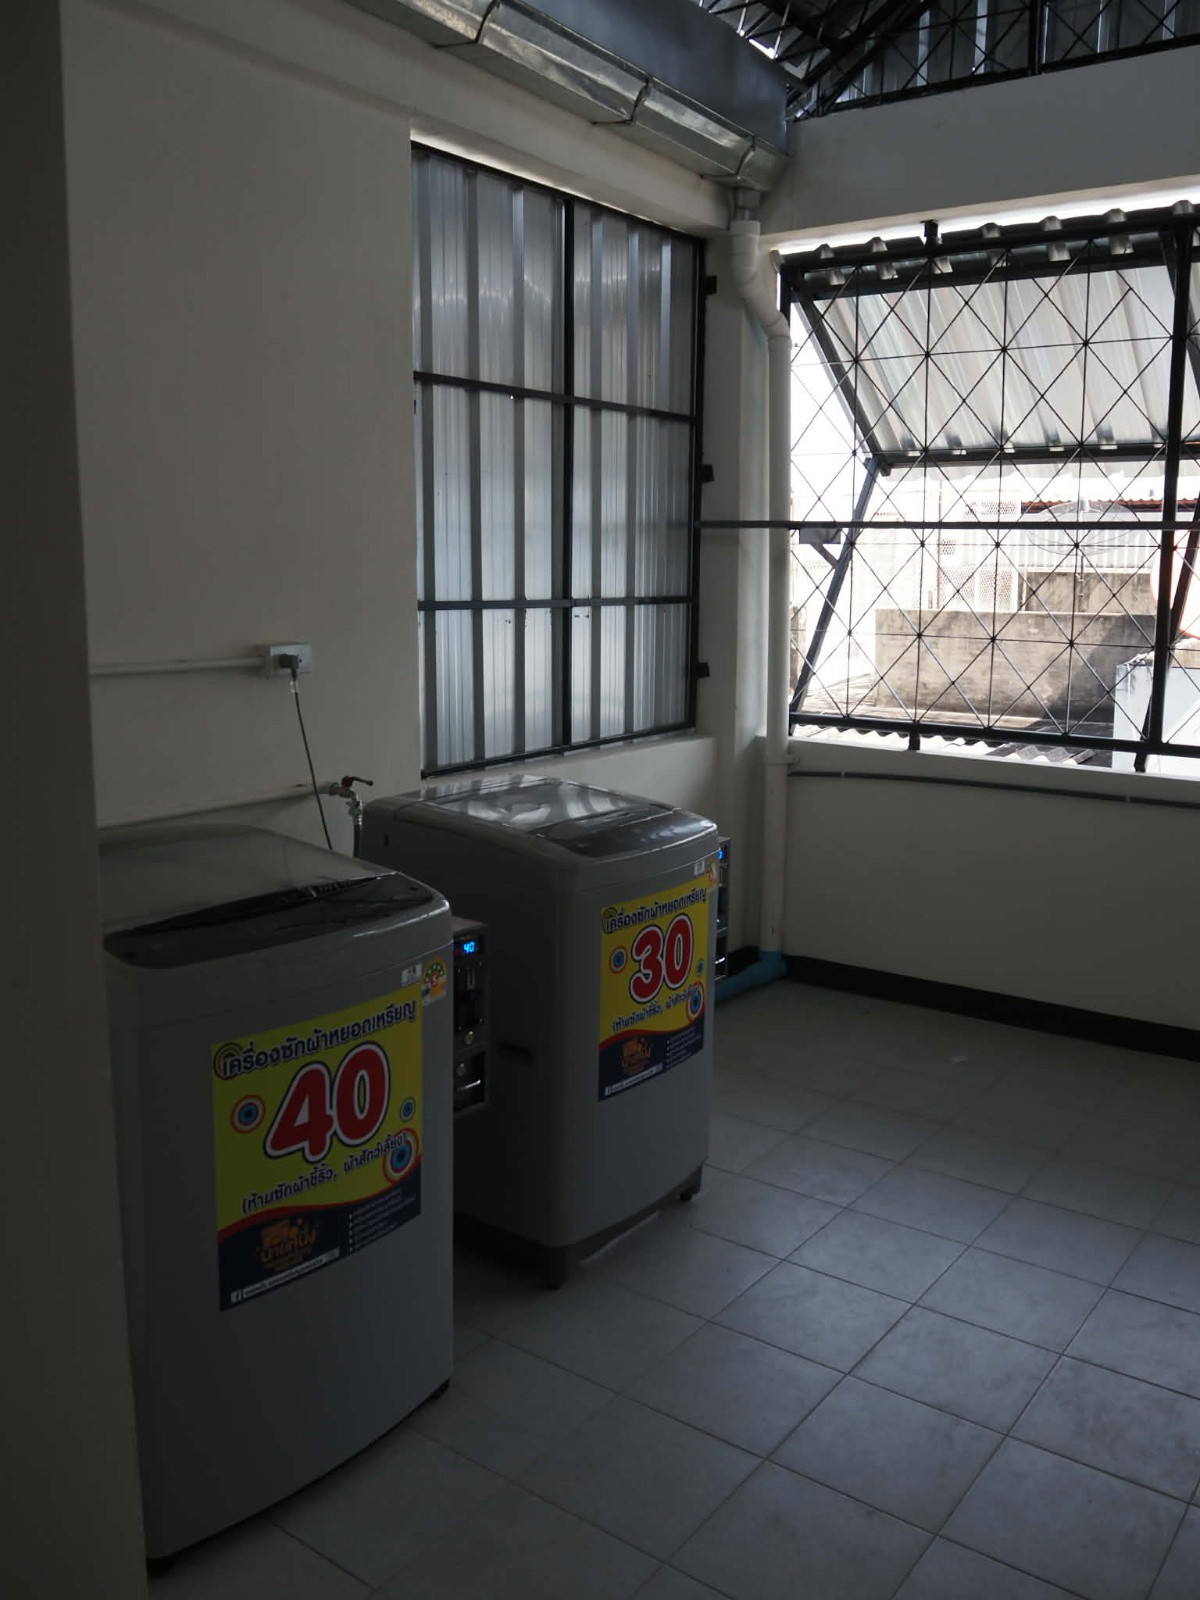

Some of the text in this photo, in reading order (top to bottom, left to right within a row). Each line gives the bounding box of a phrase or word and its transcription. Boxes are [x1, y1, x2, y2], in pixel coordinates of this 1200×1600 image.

[463, 941, 475, 953] 40
[629, 913, 694, 1004] 30
[264, 1041, 391, 1163] 40
